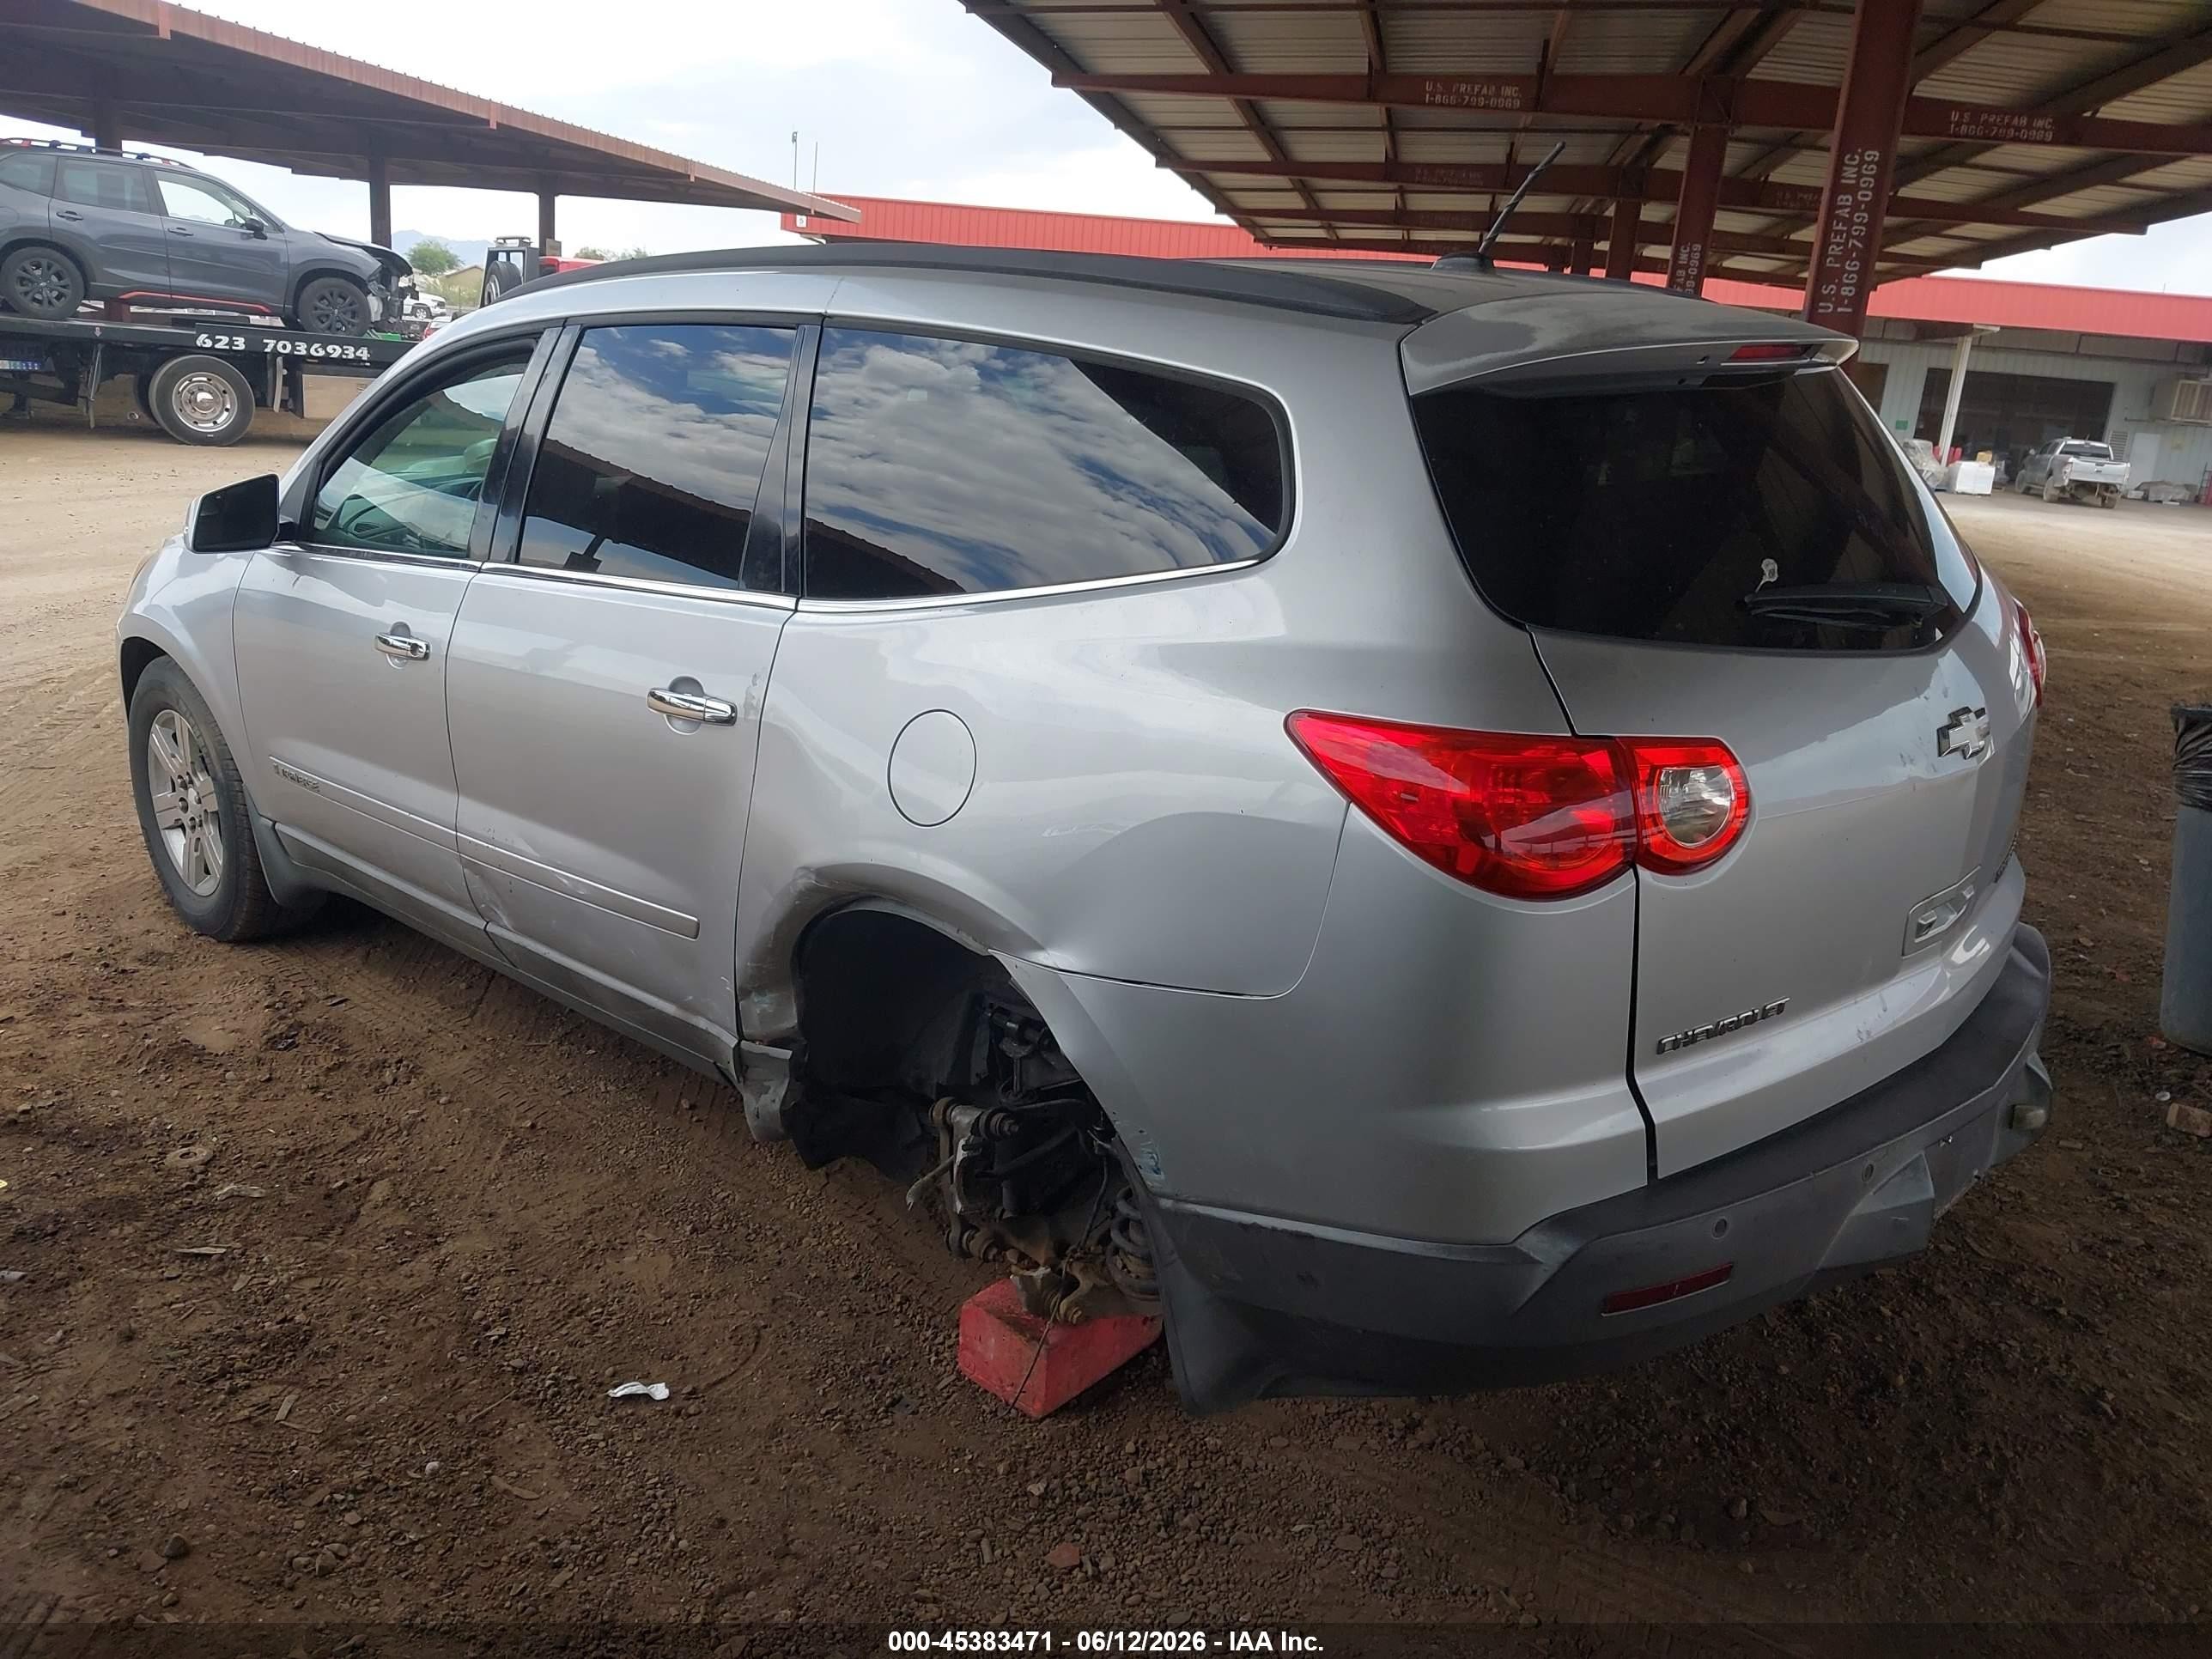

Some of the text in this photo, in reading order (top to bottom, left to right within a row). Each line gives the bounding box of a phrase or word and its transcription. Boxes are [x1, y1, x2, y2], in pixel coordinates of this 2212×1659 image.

[1980, 112, 2027, 127] PREFAB
[1818, 148, 1863, 313] U.S. PREFAB INC.
[1837, 150, 1881, 313] 1-866-799-0969
[1673, 269, 1686, 293] FAB
[1685, 243, 1702, 295] 99-0969
[195, 333, 371, 361] 623 7036934
[1656, 997, 1791, 1055] CHEVROLET
